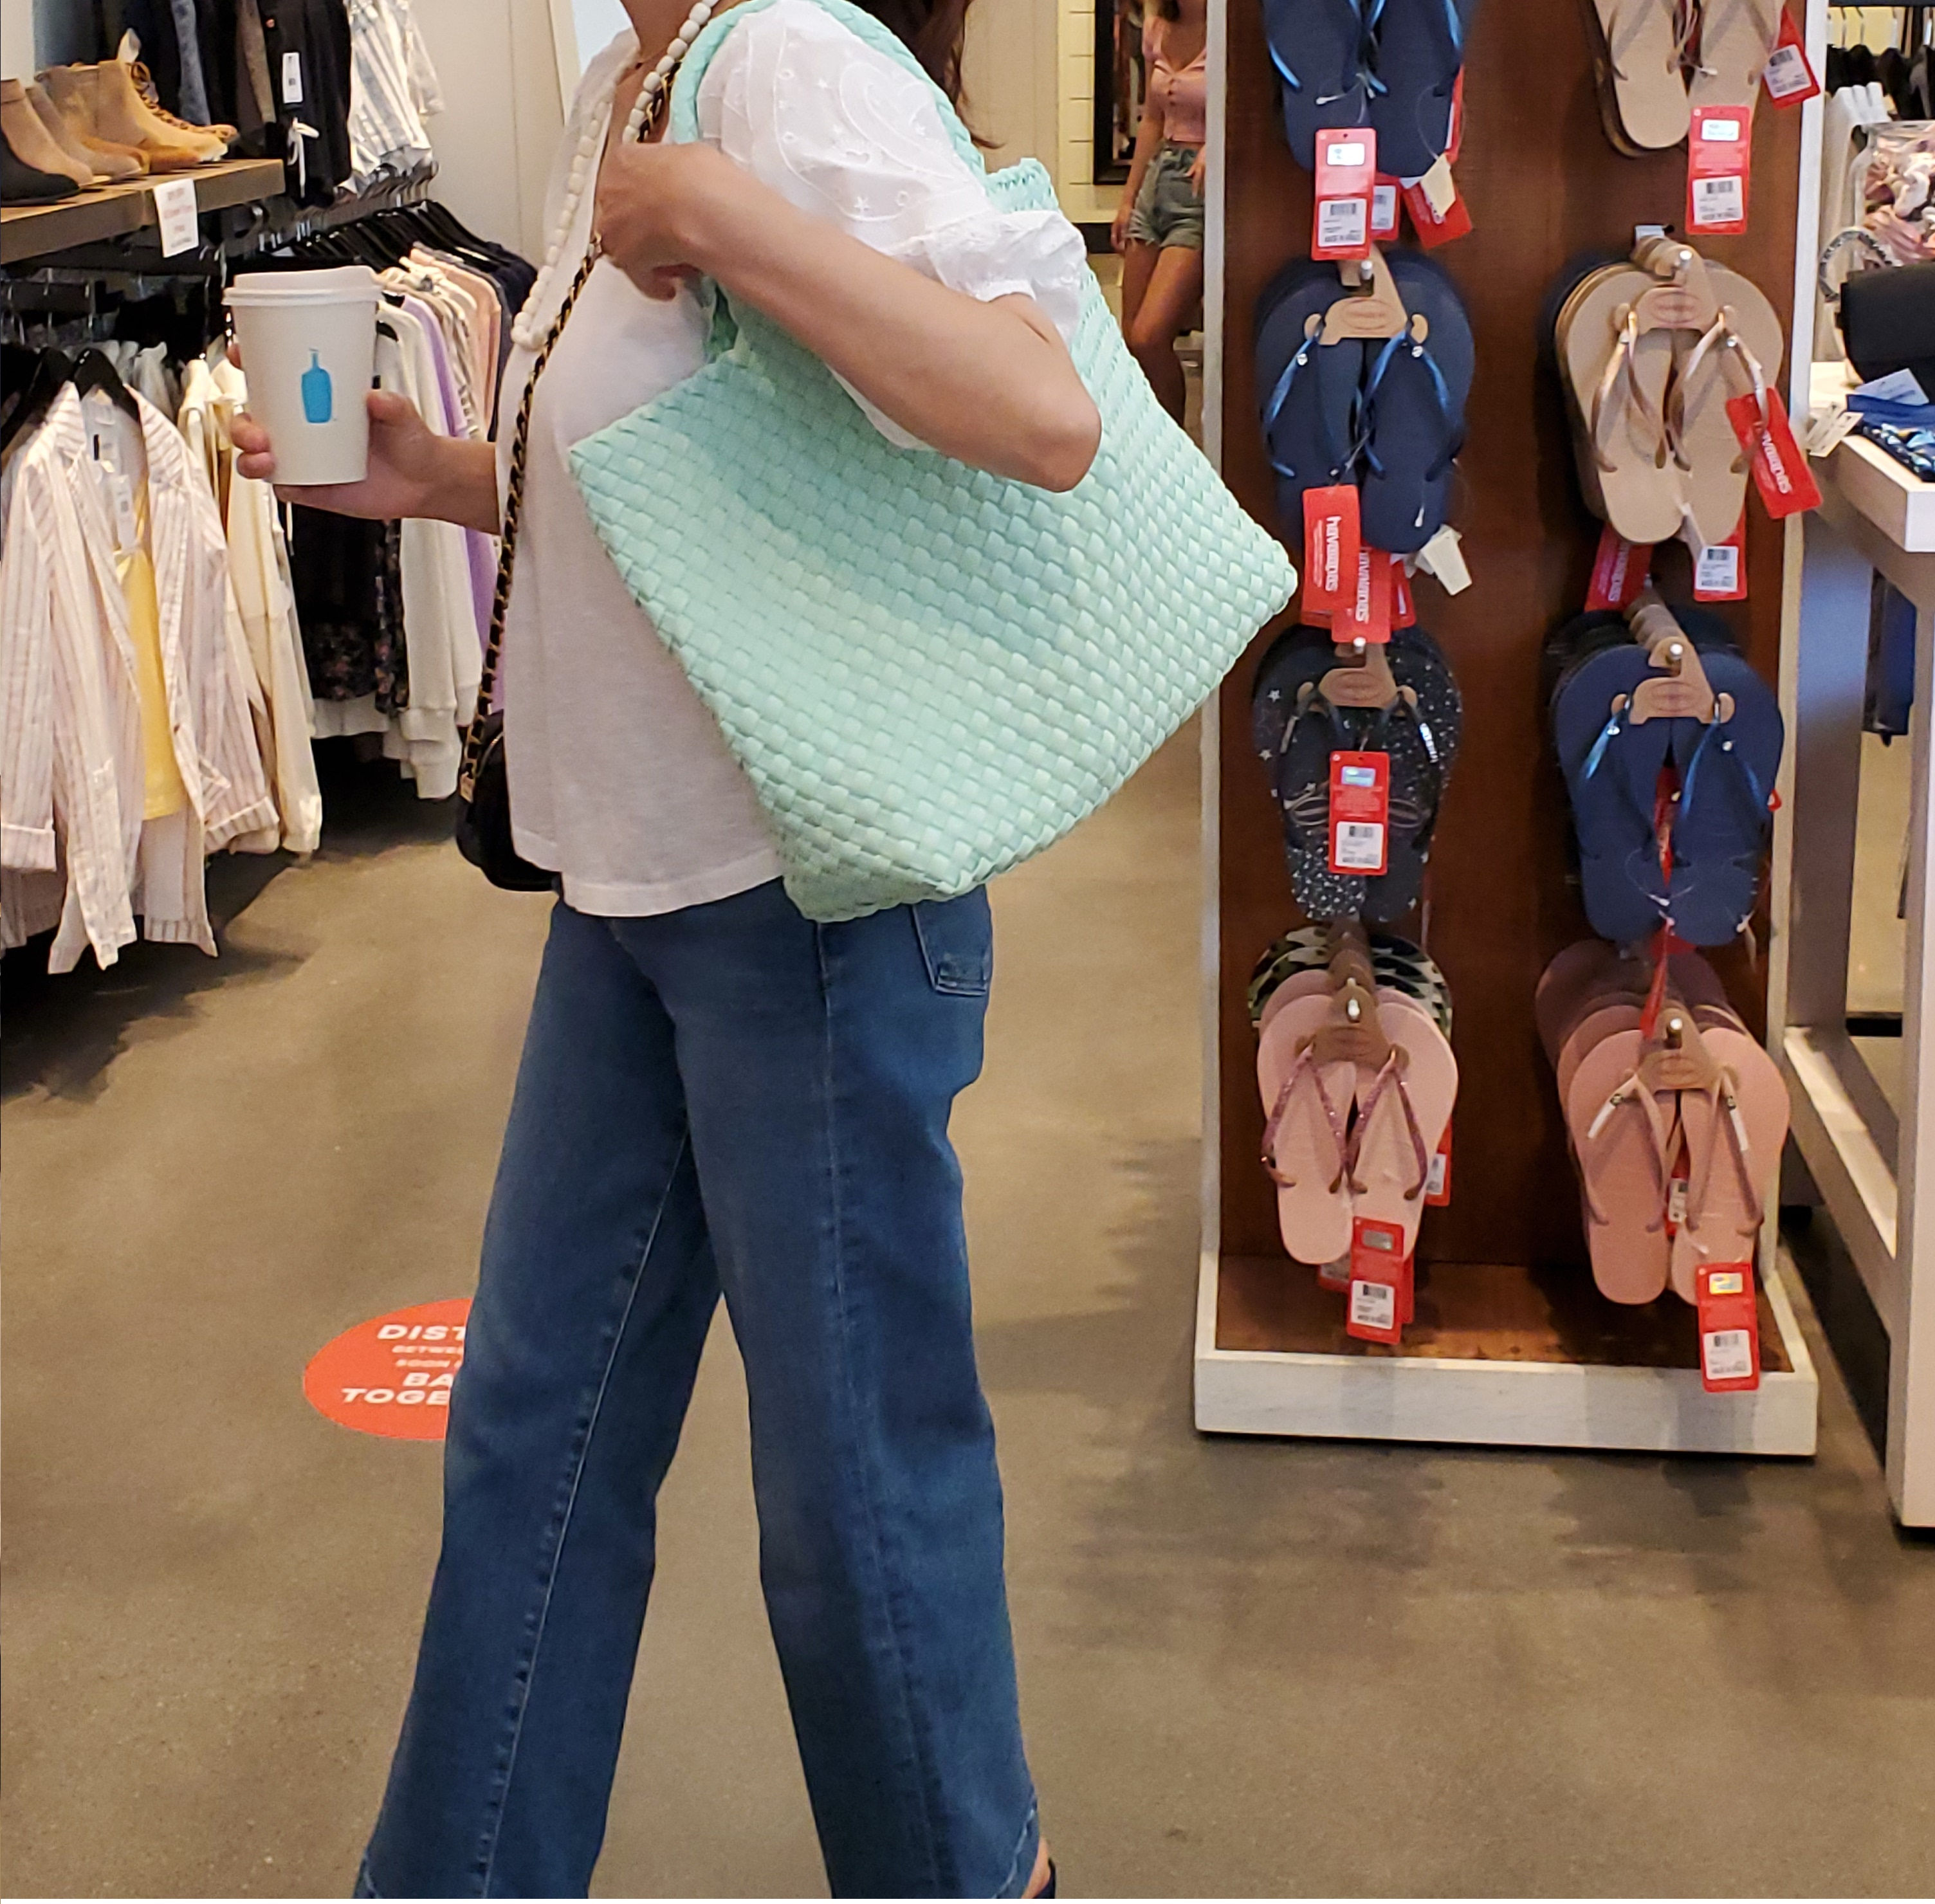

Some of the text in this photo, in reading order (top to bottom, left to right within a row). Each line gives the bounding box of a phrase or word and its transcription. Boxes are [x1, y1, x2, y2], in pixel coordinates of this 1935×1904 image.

[377, 1324, 466, 1341] DIST
[403, 1372, 454, 1387] BA
[342, 1388, 450, 1405] TOGE
